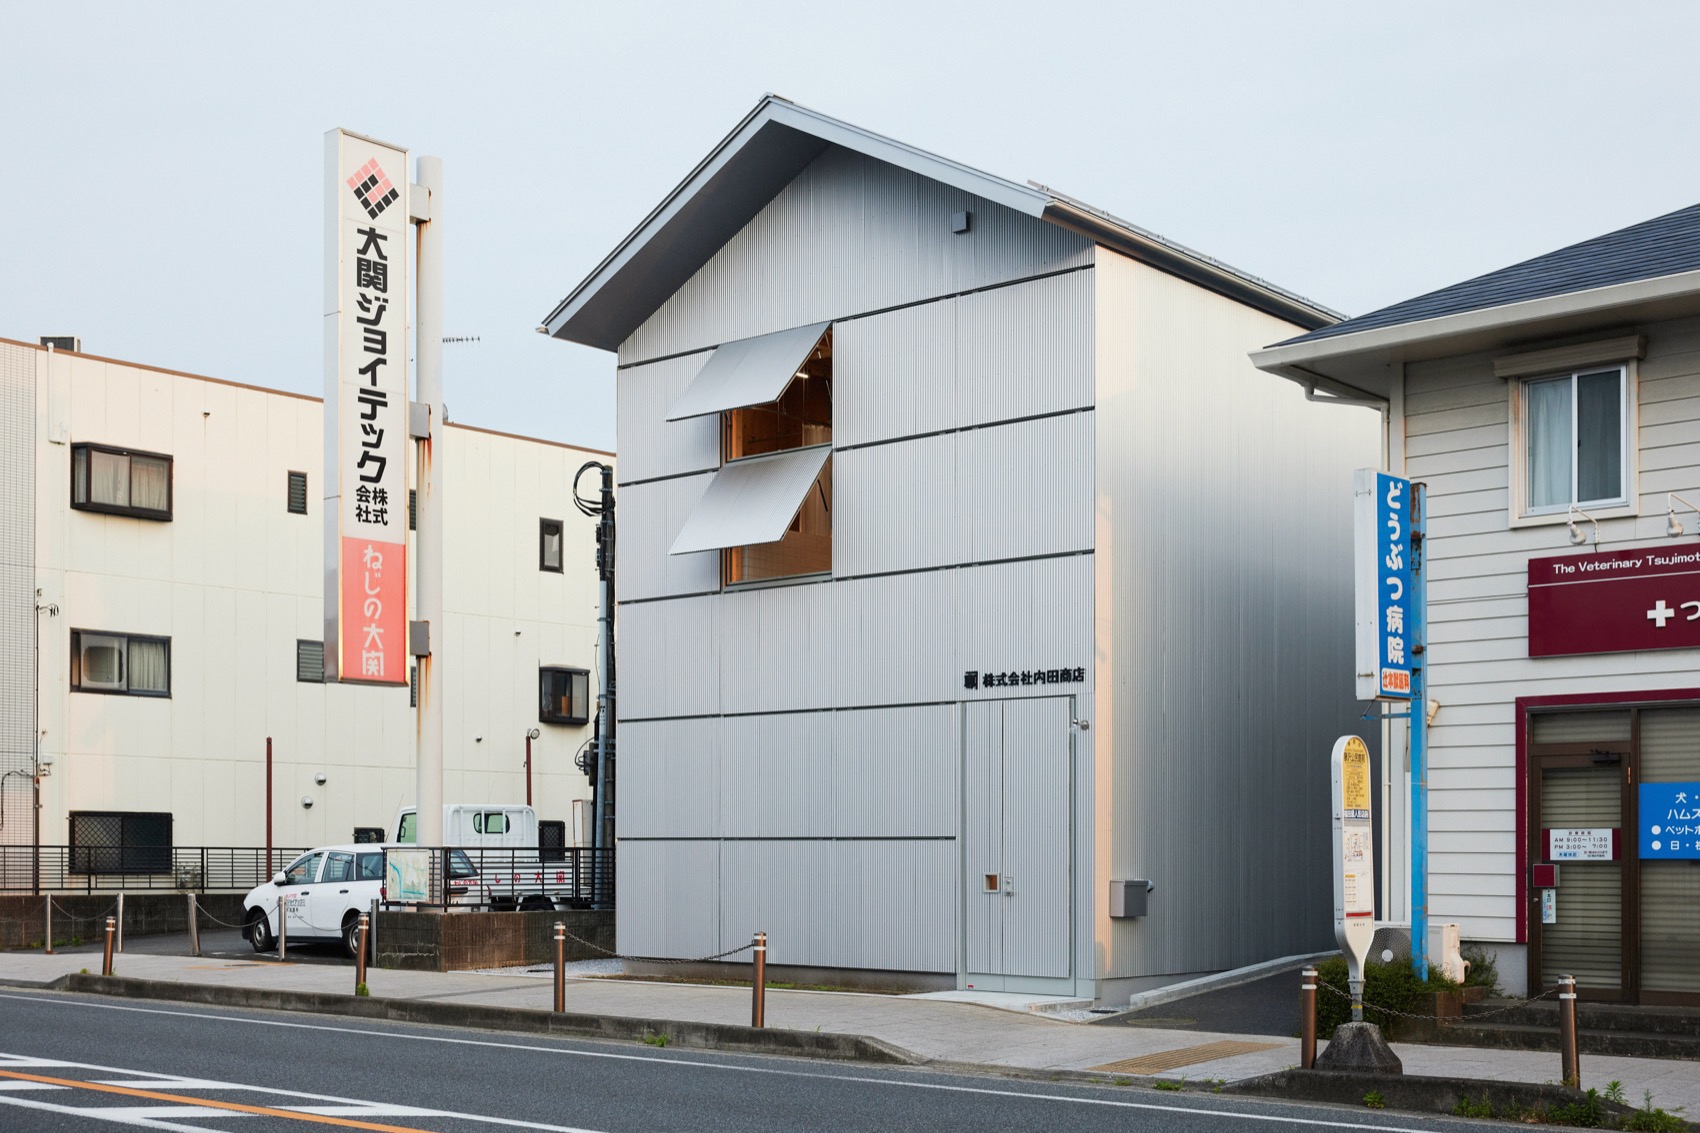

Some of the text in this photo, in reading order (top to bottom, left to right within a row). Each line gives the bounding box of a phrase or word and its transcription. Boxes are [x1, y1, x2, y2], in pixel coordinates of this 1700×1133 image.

[356, 226, 388, 484] 大関ジョイテック
[356, 485, 388, 526] 株式会社
[1386, 481, 1404, 665] どうぶつ病院
[1553, 563, 1575, 574] The
[1578, 558, 1642, 572] Veterinary
[362, 544, 385, 677] ねじの大関
[983, 667, 1085, 688] 株式会社内田商店
